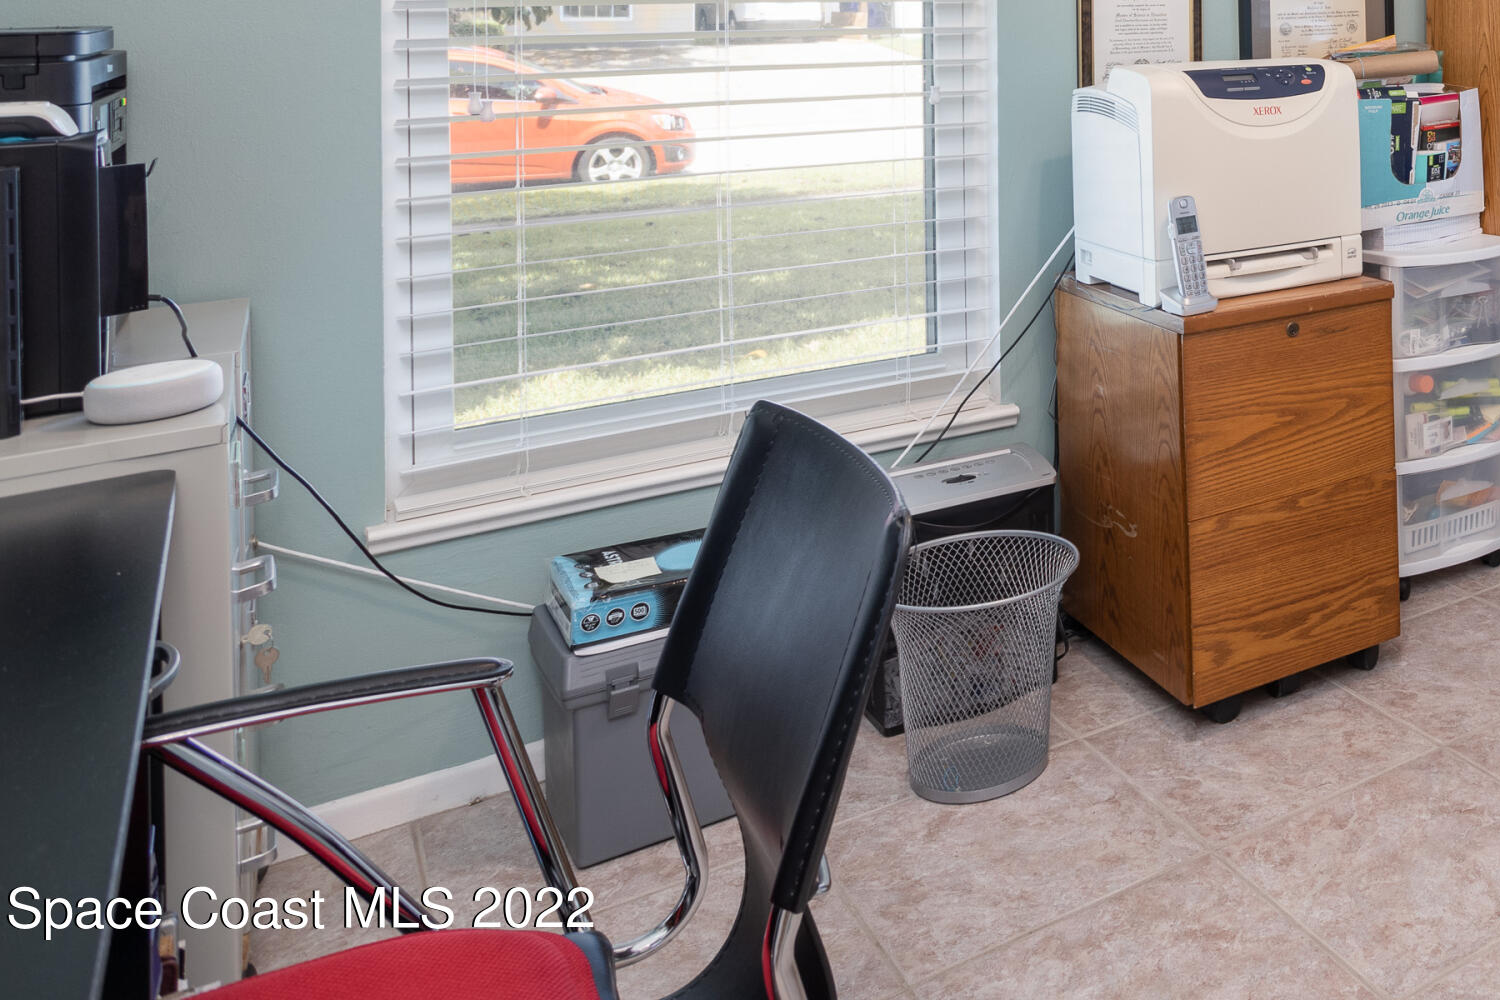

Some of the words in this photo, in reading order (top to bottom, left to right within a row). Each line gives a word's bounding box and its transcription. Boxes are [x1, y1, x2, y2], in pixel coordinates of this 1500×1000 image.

[1253, 105, 1282, 116] XEROX
[1396, 209, 1429, 223] Orange
[1430, 204, 1451, 218] Juice
[634, 606, 645, 614] 500
